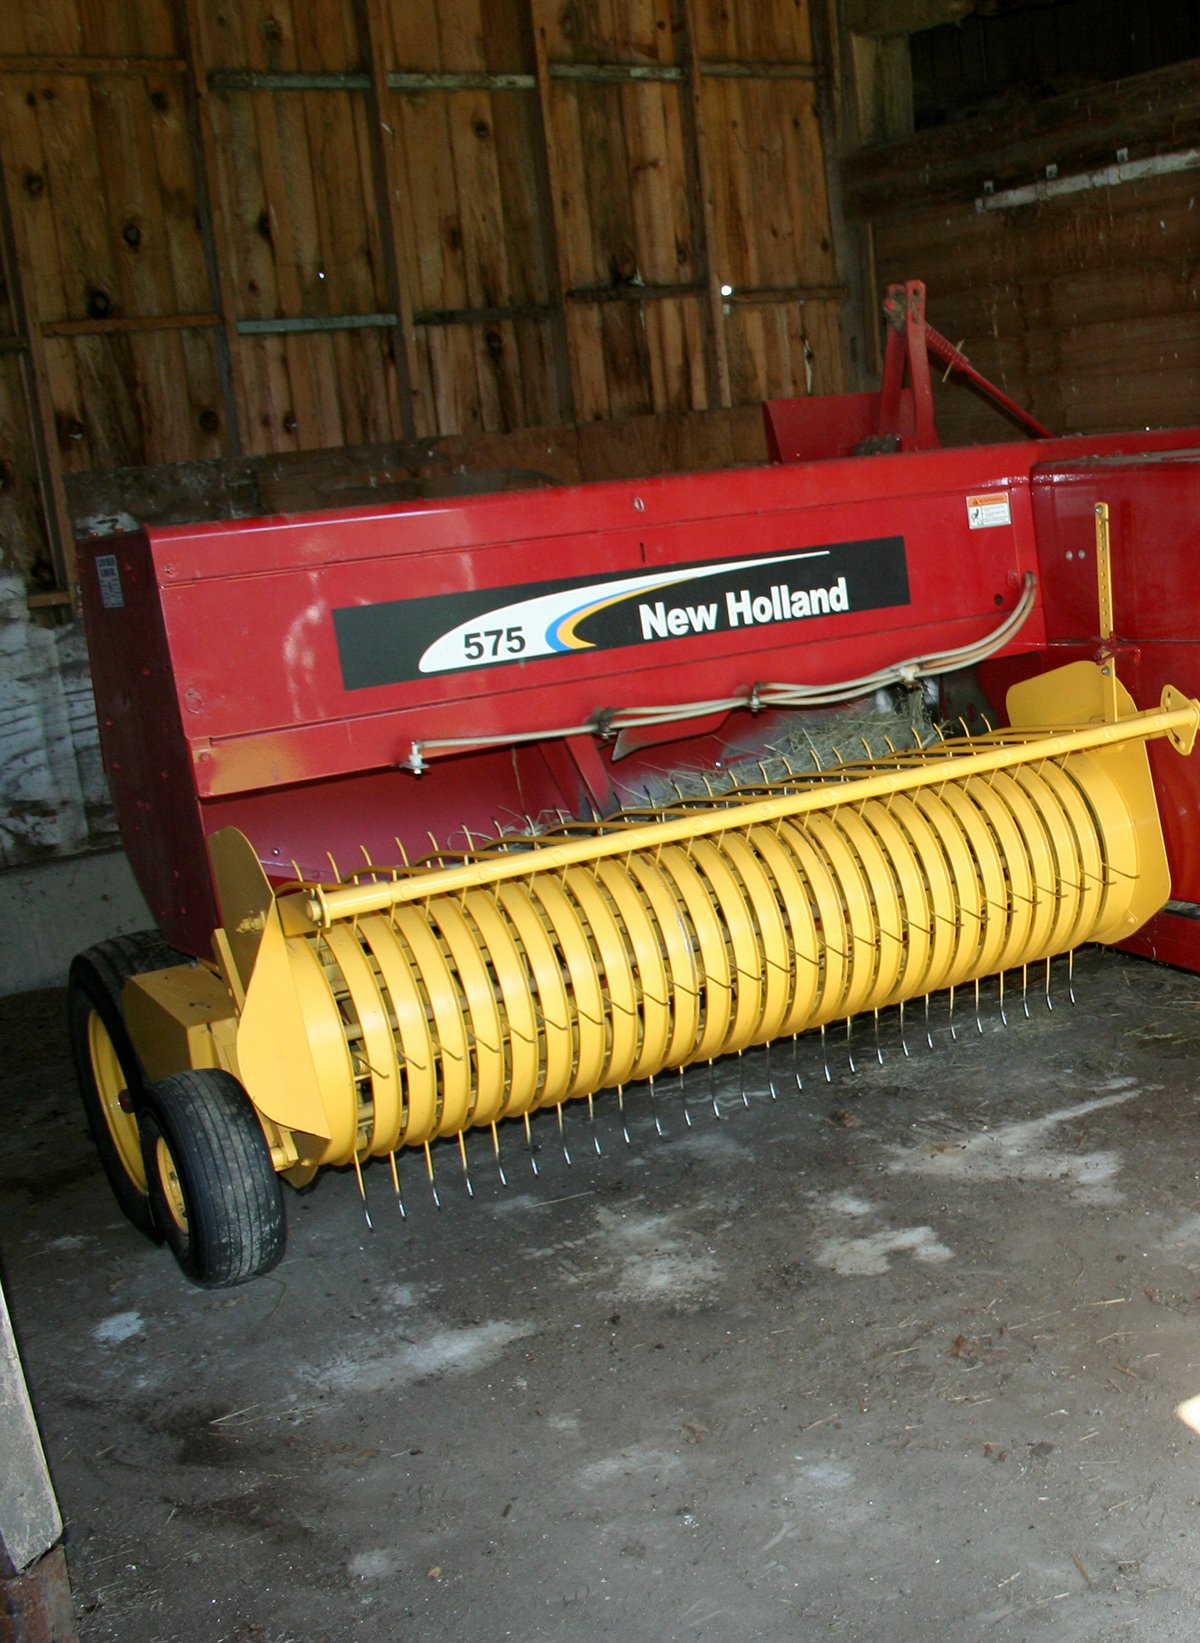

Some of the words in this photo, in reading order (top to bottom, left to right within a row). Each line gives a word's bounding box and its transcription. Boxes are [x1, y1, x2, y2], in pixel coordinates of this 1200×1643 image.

[639, 602, 718, 640] New
[725, 577, 849, 627] Holland
[464, 626, 526, 660] 575
